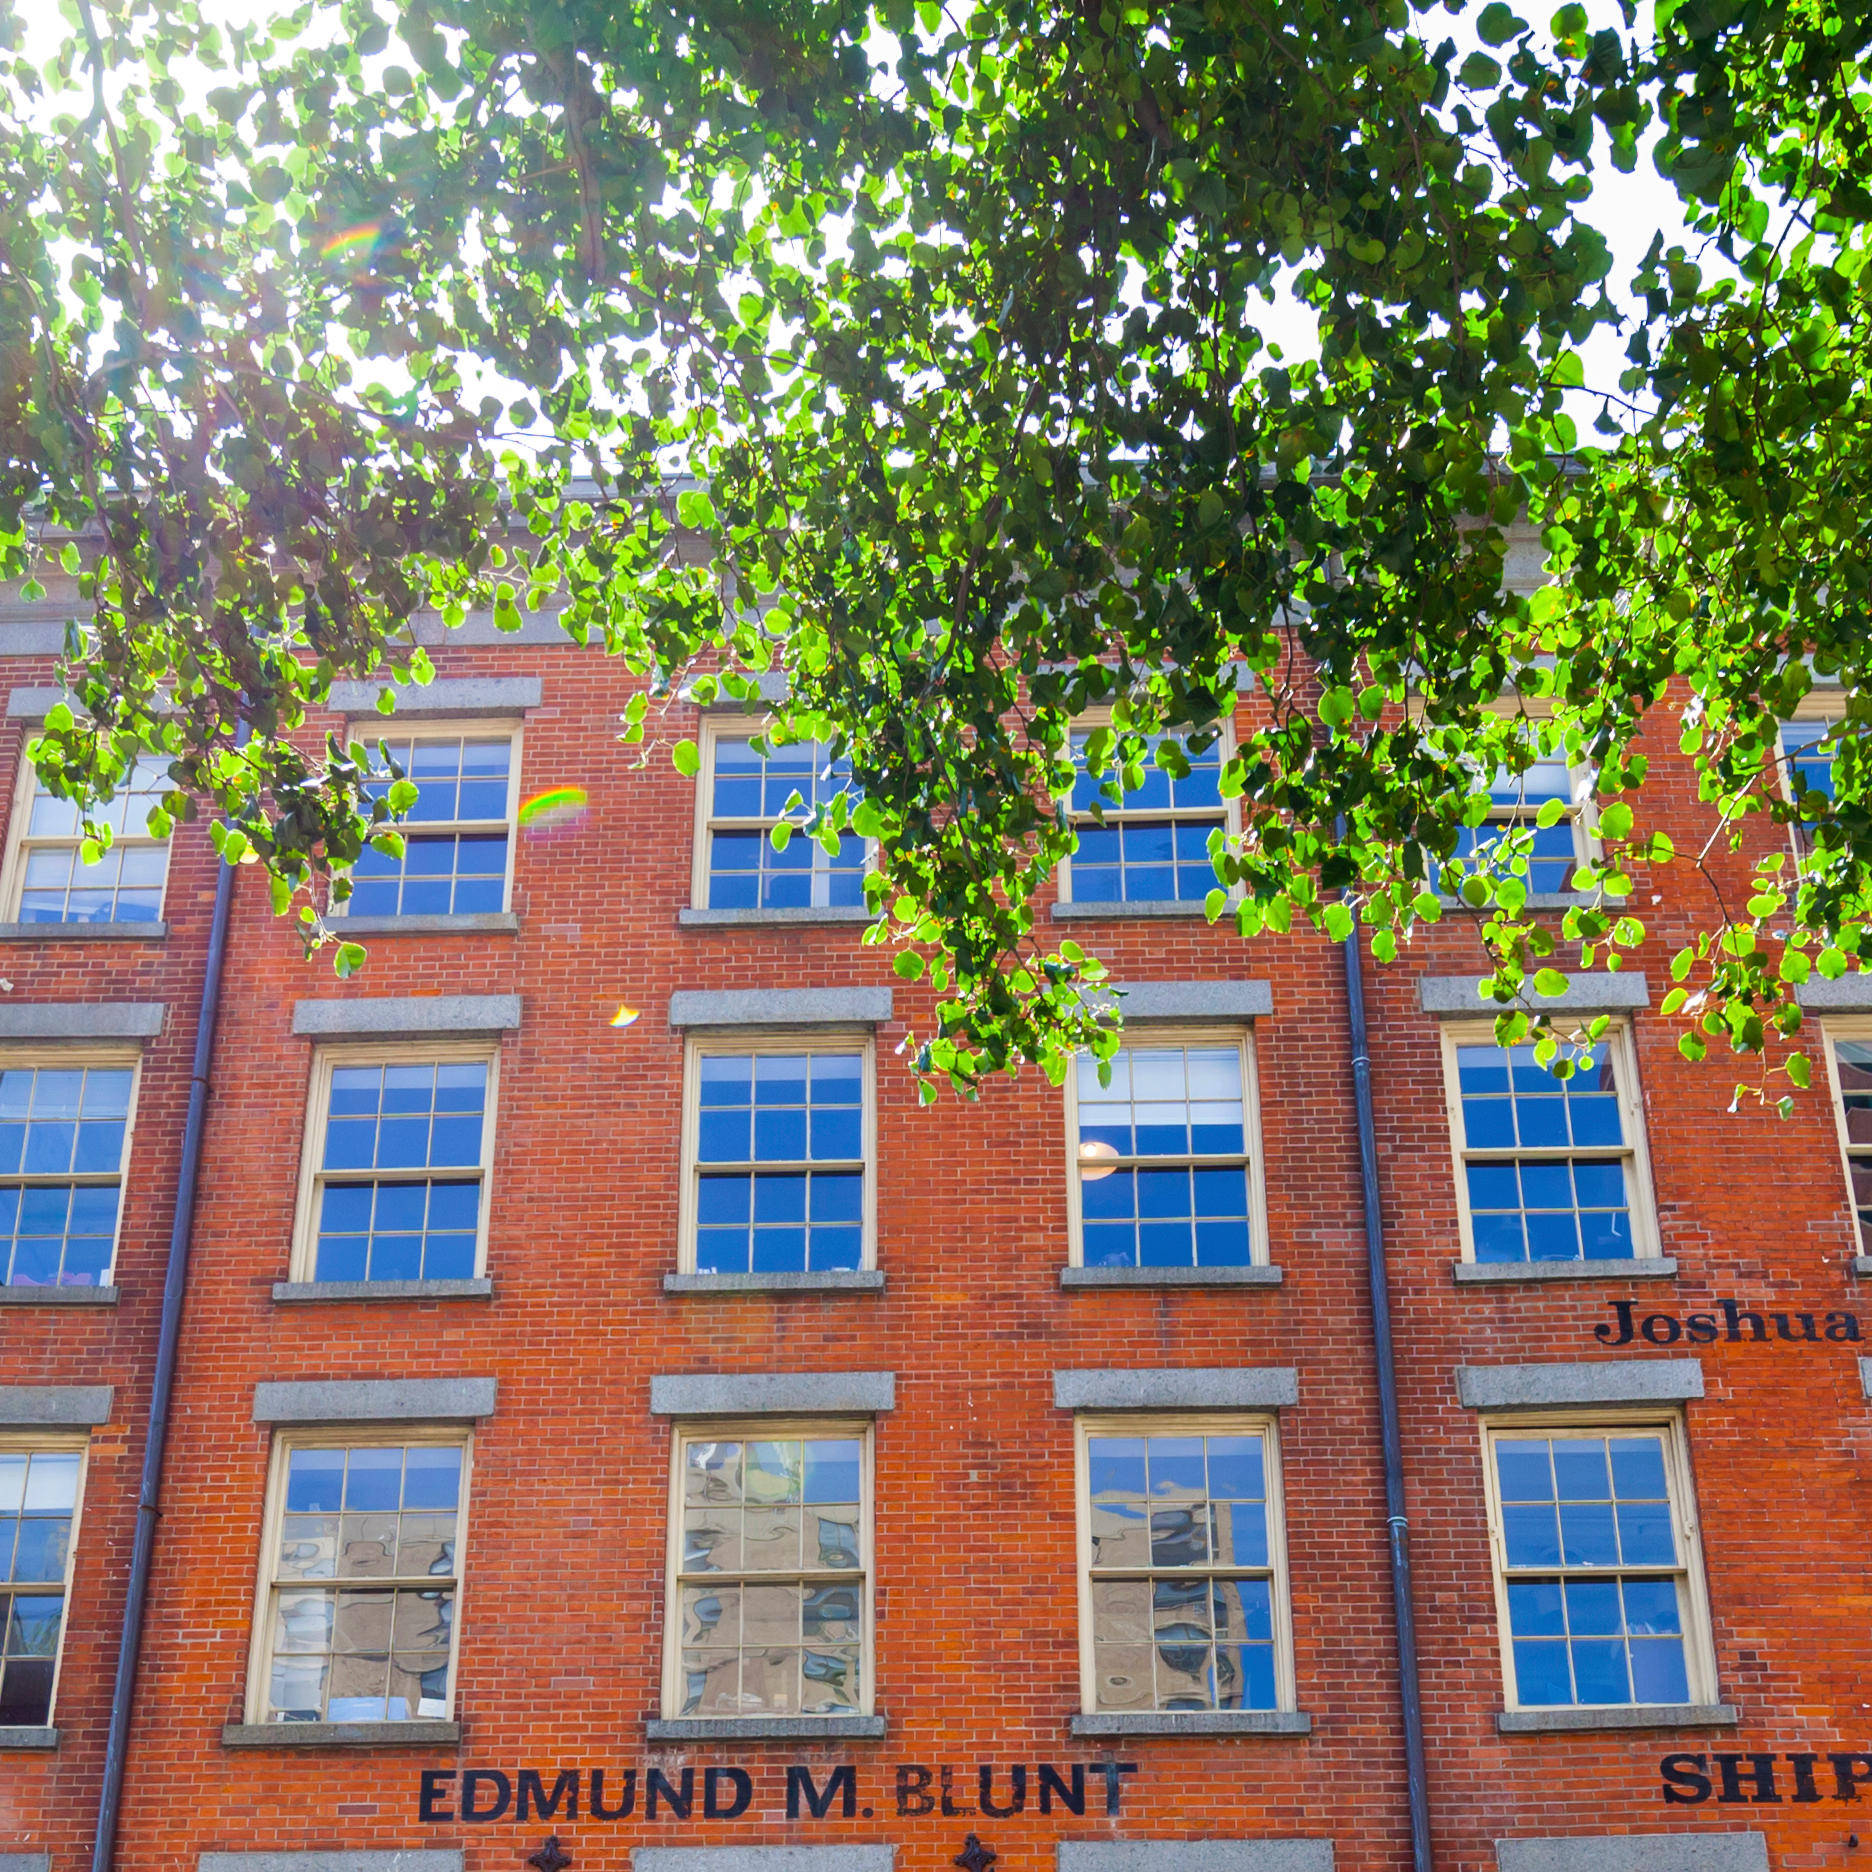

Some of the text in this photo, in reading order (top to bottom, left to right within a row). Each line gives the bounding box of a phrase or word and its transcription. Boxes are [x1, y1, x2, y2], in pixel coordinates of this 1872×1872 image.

[1594, 1298, 1864, 1346] Joshua
[418, 1762, 1138, 1822] EDMUND M. BLUNT
